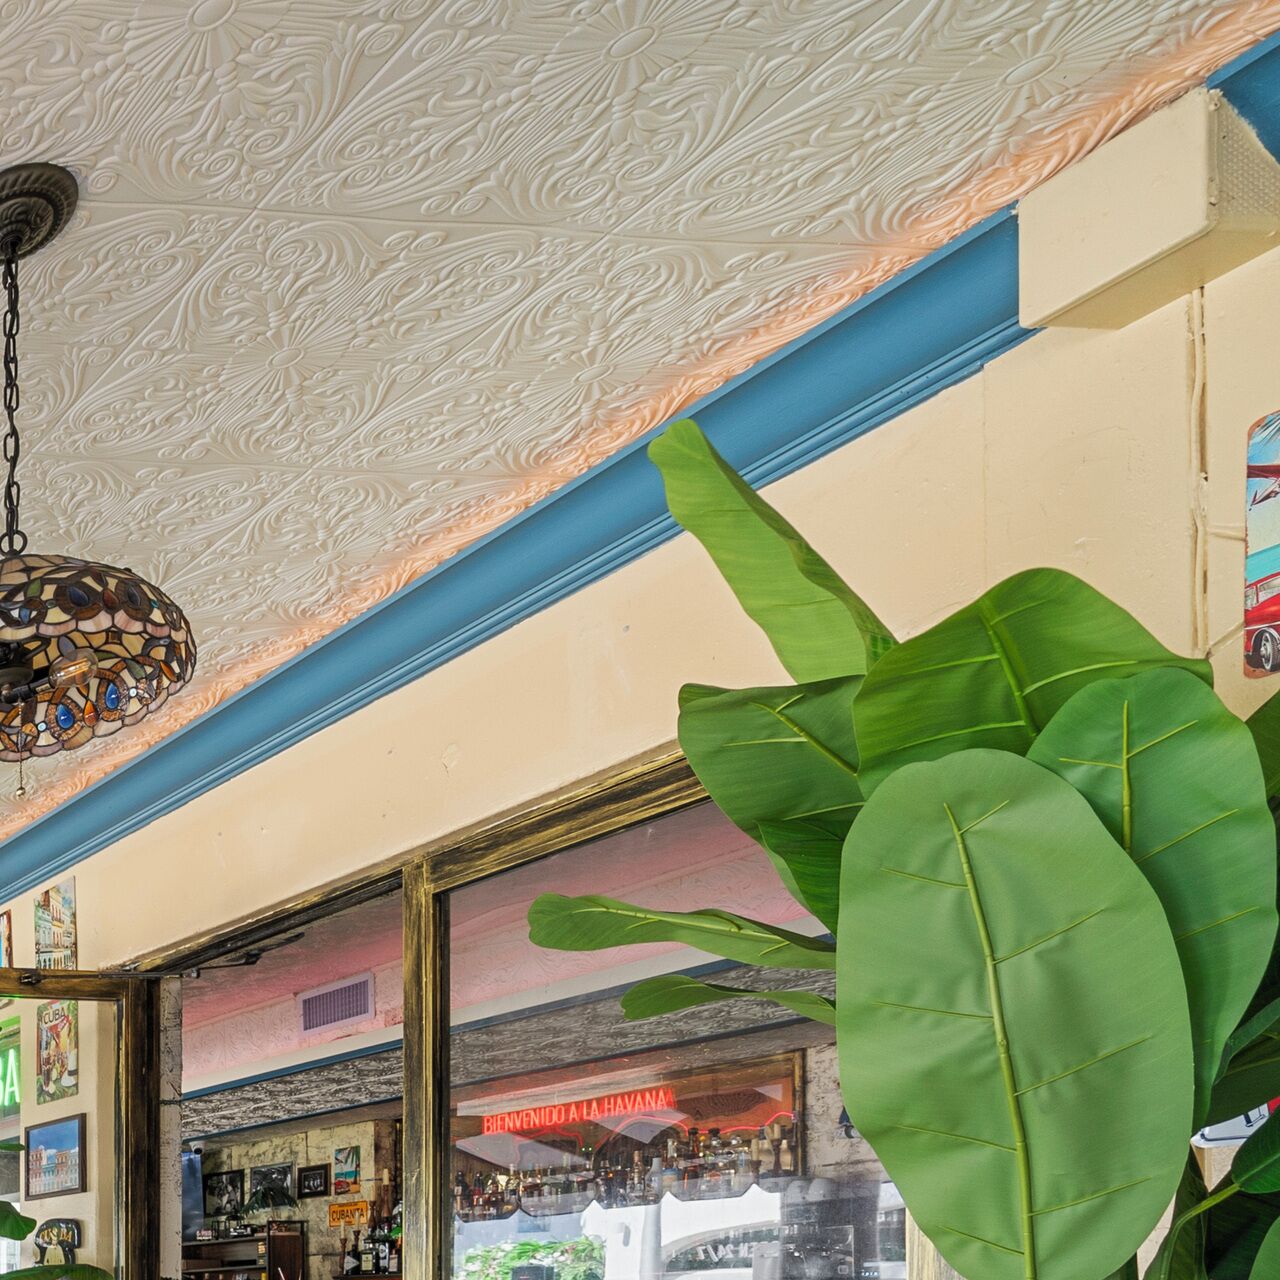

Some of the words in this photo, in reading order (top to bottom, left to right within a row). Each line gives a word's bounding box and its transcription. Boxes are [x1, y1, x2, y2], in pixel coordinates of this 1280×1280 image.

[43, 1006, 66, 1025] CUBA
[483, 1106, 565, 1134] BIENVENIDO
[569, 1103, 578, 1122] A
[583, 1099, 599, 1121] LA
[604, 1088, 668, 1117] HAVANA
